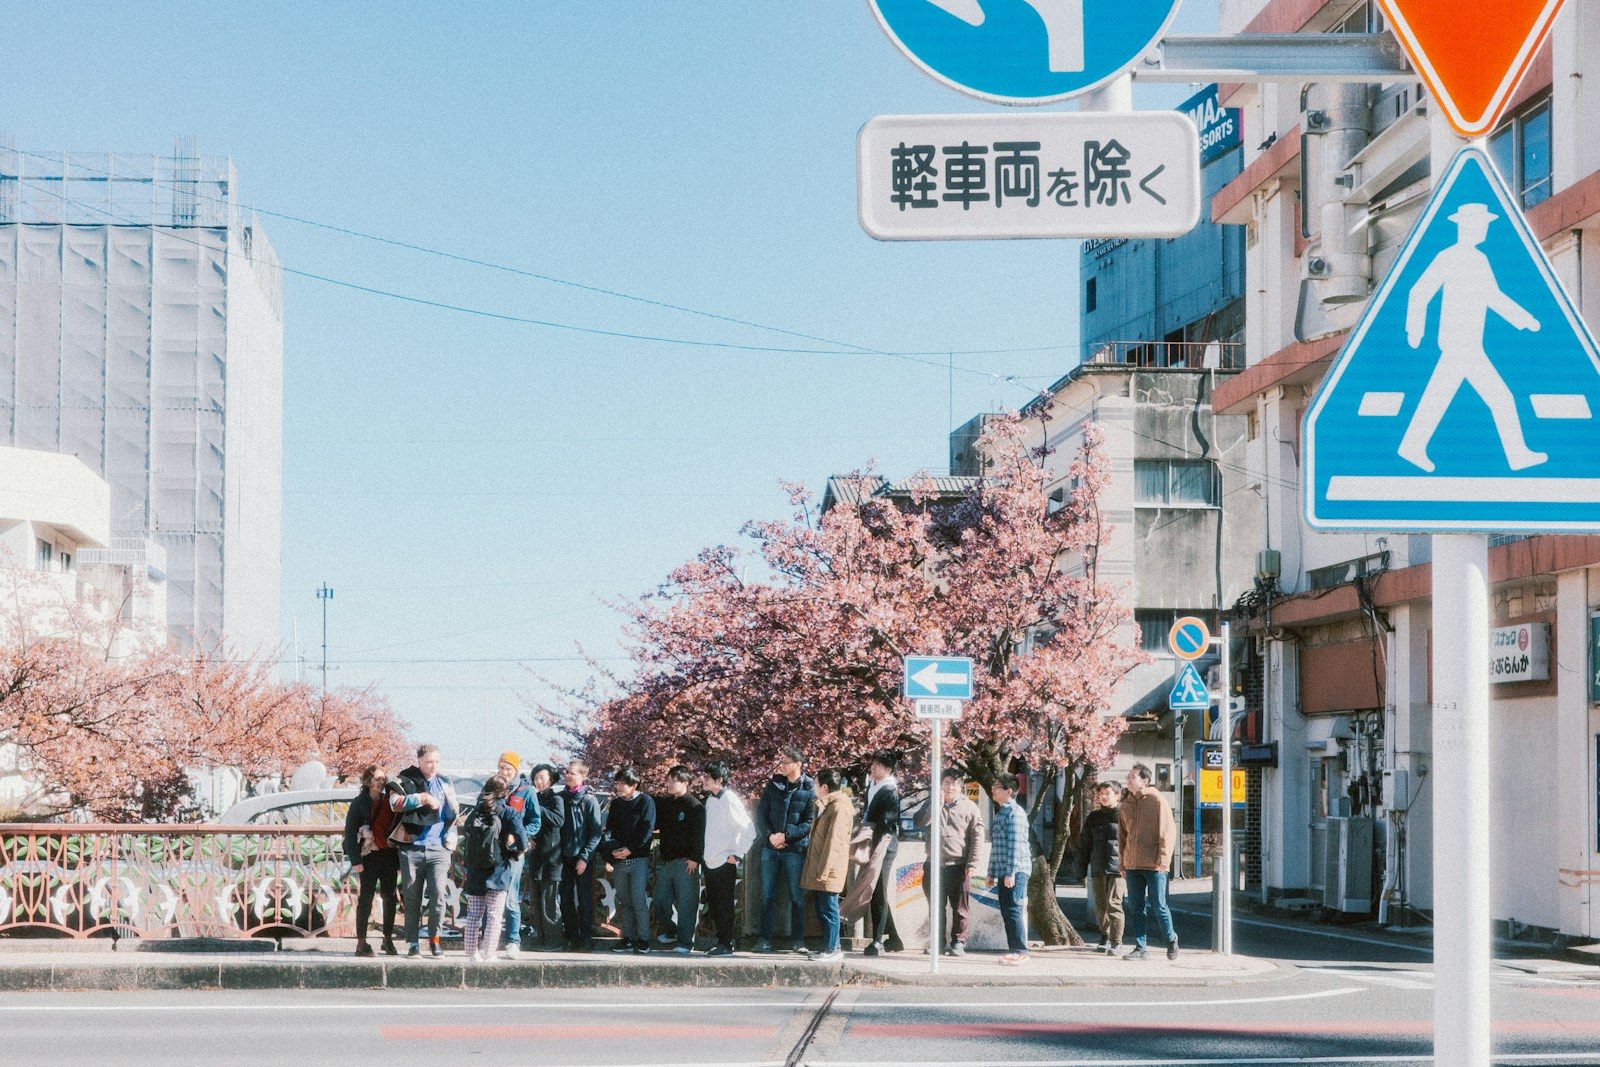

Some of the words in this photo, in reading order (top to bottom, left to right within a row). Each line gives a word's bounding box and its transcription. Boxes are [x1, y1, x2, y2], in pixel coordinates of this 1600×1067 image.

[890, 139, 1167, 212] 軽車両を除く
[1216, 775, 1241, 790] 80
